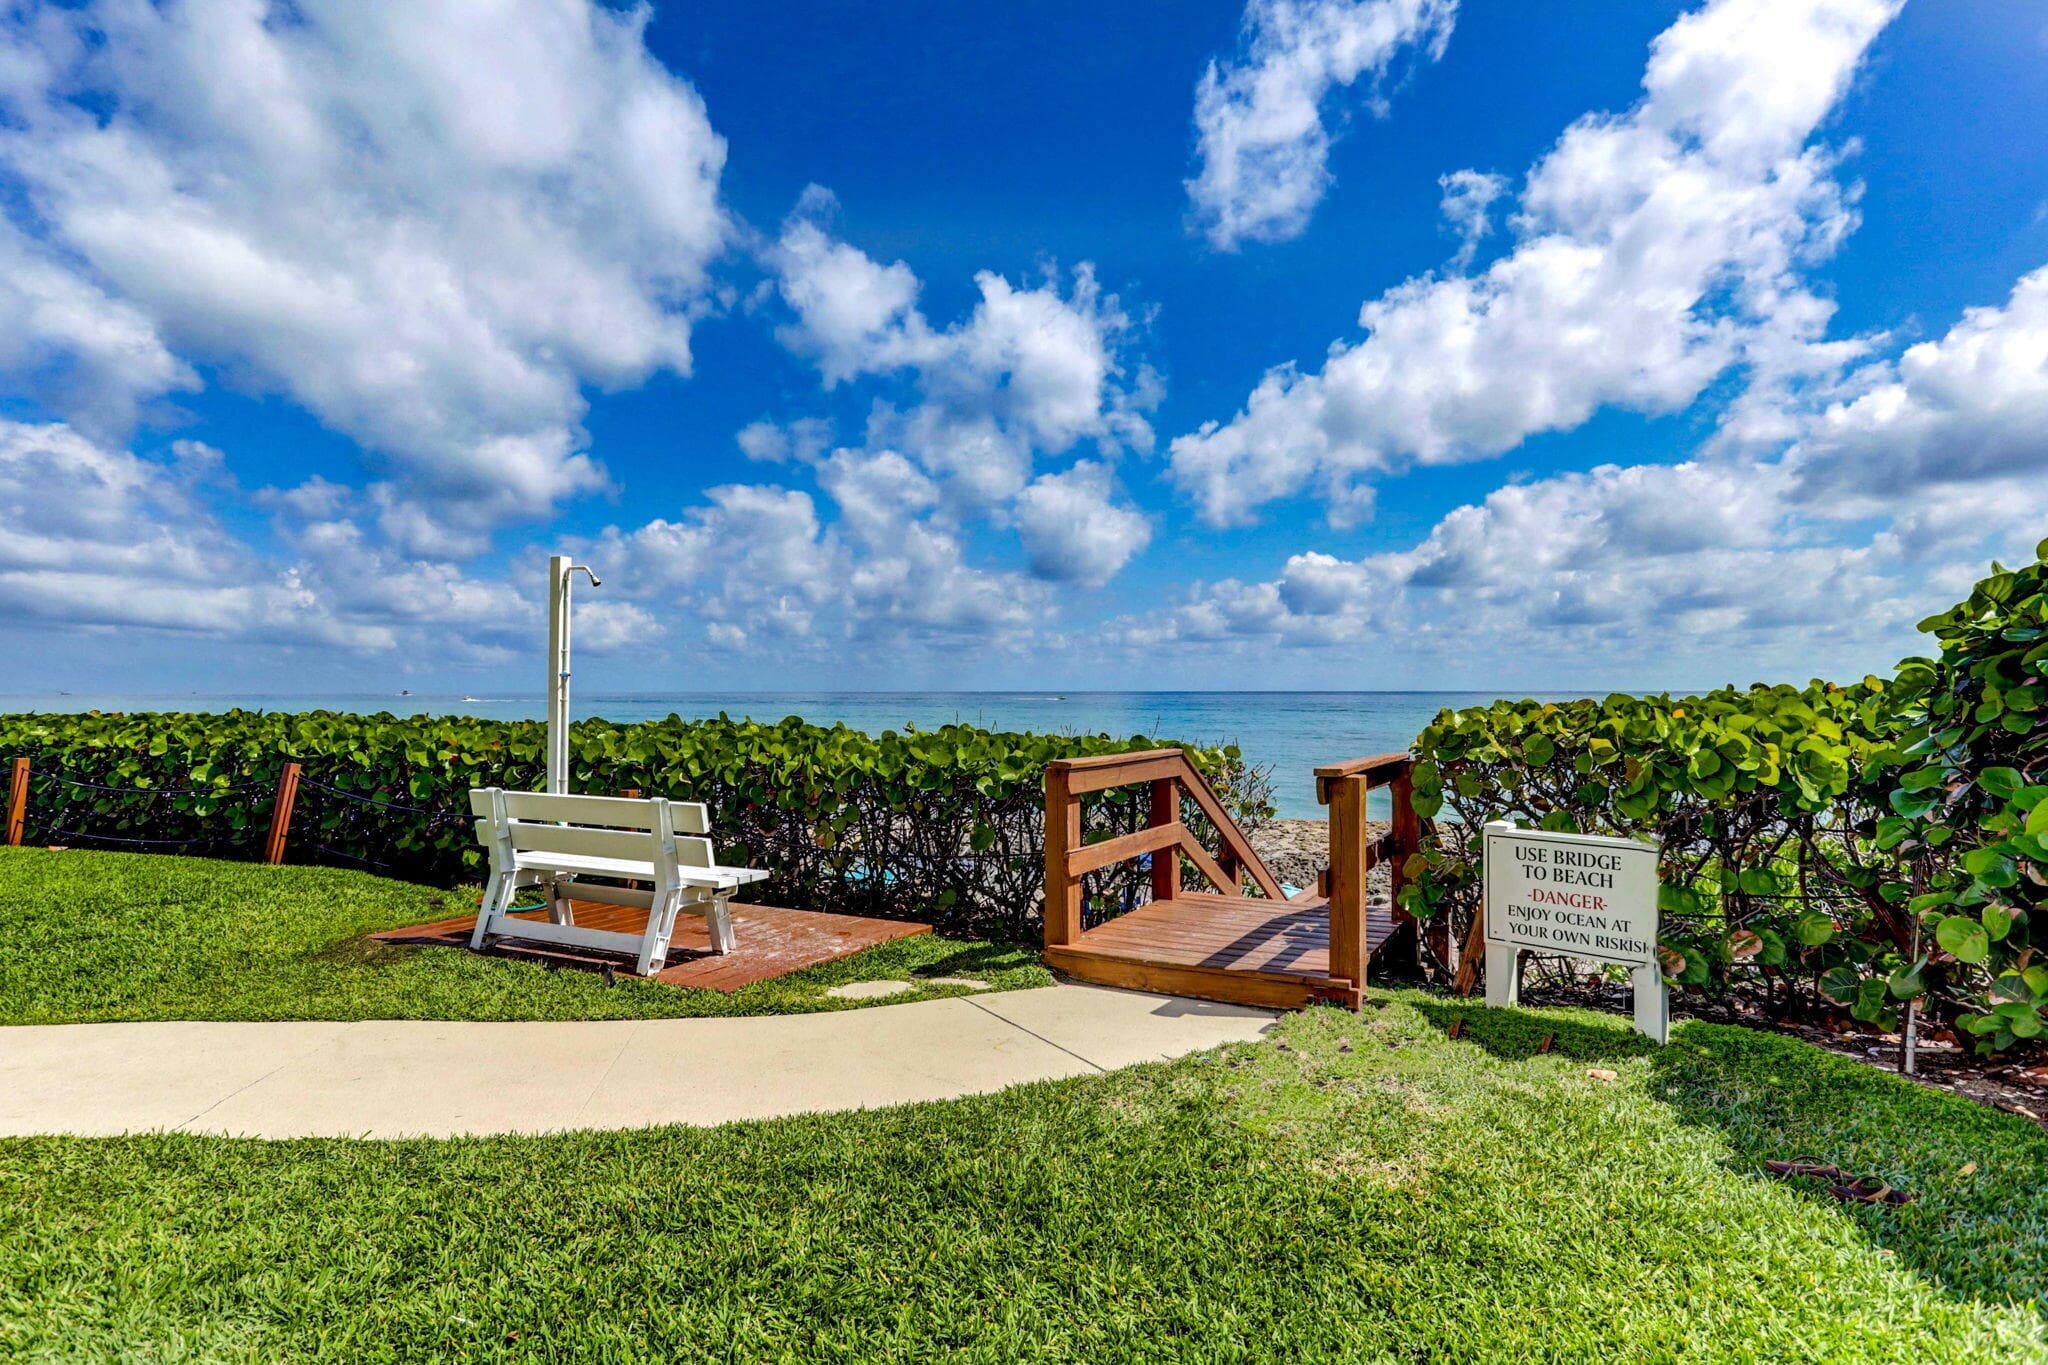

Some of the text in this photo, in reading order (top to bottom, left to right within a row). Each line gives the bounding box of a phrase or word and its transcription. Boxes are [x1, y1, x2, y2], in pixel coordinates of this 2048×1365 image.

[1515, 846, 1622, 871] USE BRIDGE
[1522, 864, 1613, 889] TO BEACH
[1508, 904, 1631, 933] ENJOY OCEAN AT
[1509, 922, 1548, 939] YOUR
[1552, 929, 1590, 946] OWN
